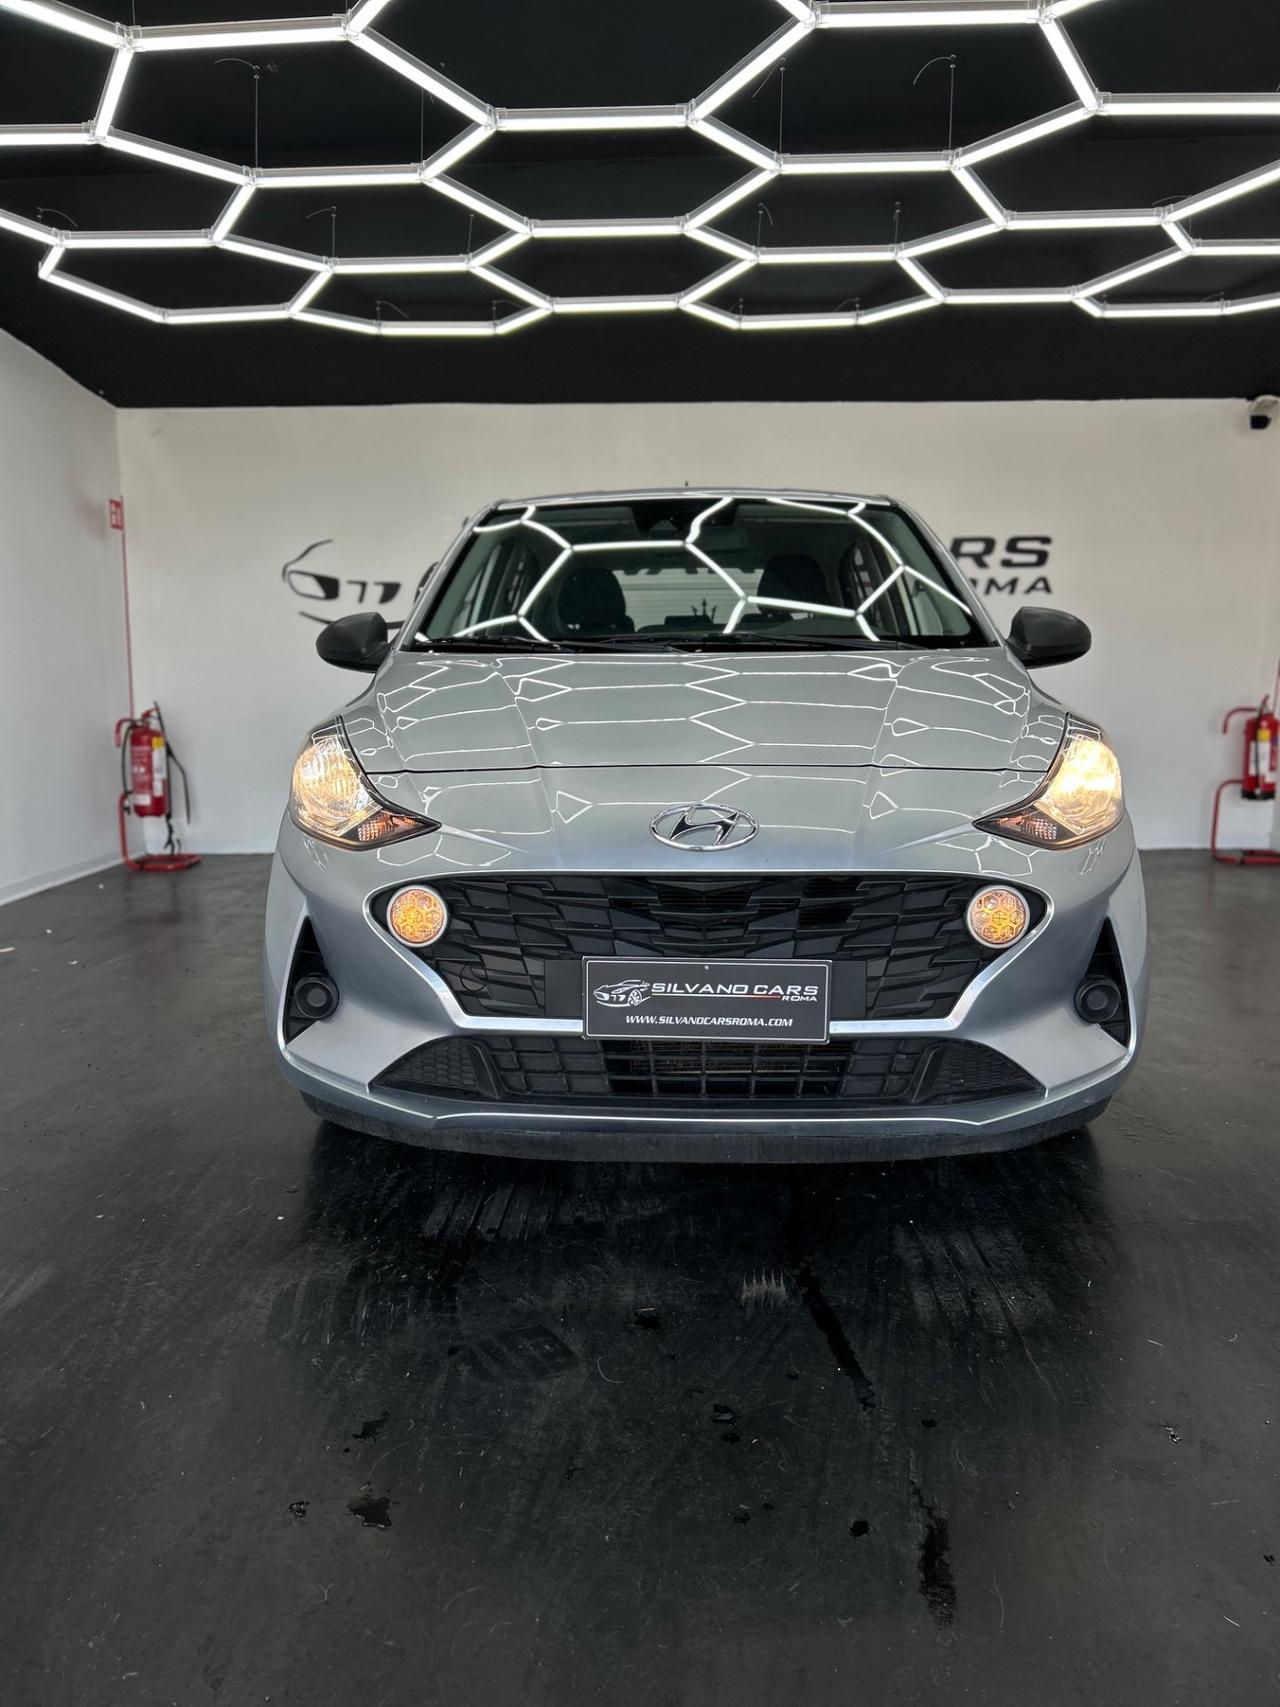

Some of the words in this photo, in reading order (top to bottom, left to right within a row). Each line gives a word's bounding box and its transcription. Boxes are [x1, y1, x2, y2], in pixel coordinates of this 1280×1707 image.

[950, 535, 1053, 569] RS
[970, 576, 1053, 596] MA
[651, 982, 749, 995] SILVANO
[753, 984, 819, 996] CARS
[781, 995, 818, 1003] ROMA
[625, 1015, 794, 1028] WWW.SILVANOCARSROMA.COM
